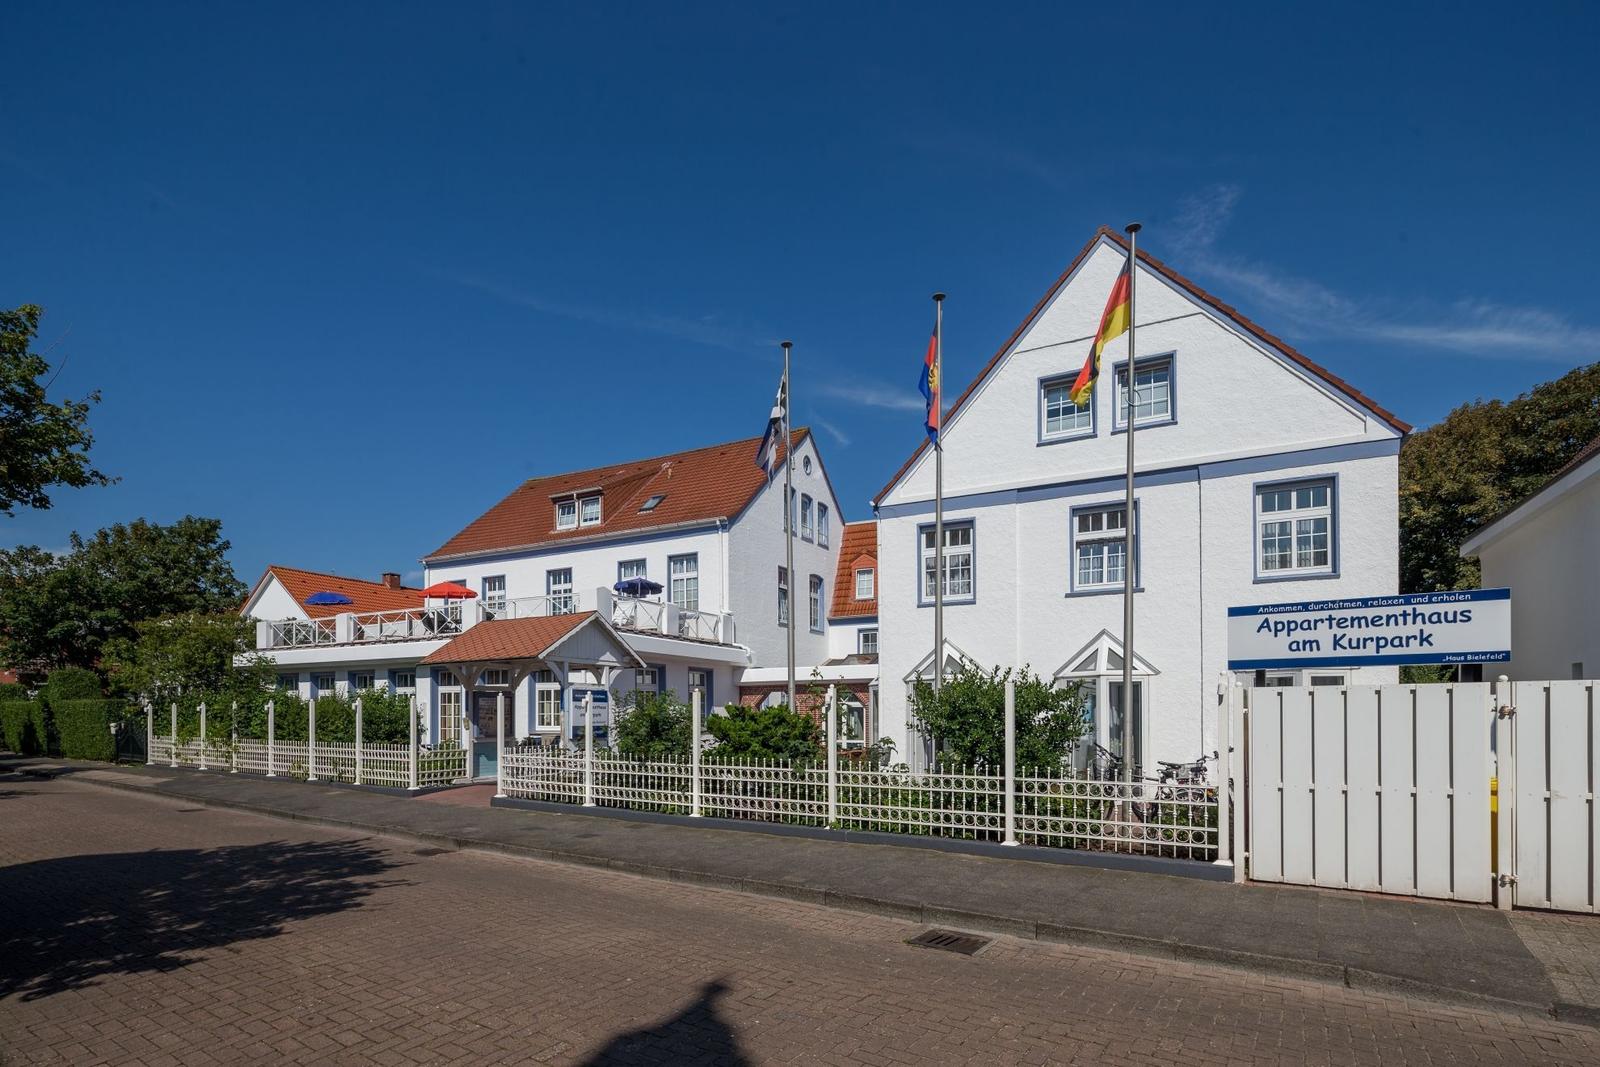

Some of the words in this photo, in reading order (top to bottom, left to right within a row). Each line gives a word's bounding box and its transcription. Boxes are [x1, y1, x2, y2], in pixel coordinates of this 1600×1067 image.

[1258, 605, 1305, 613] Ankommen,
[1368, 598, 1404, 607] relaxen
[1411, 595, 1428, 604] und
[1432, 593, 1471, 602] erholen
[1256, 607, 1472, 638] Appartementhaus
[1288, 638, 1320, 653] am
[1332, 629, 1434, 654] Kurpark
